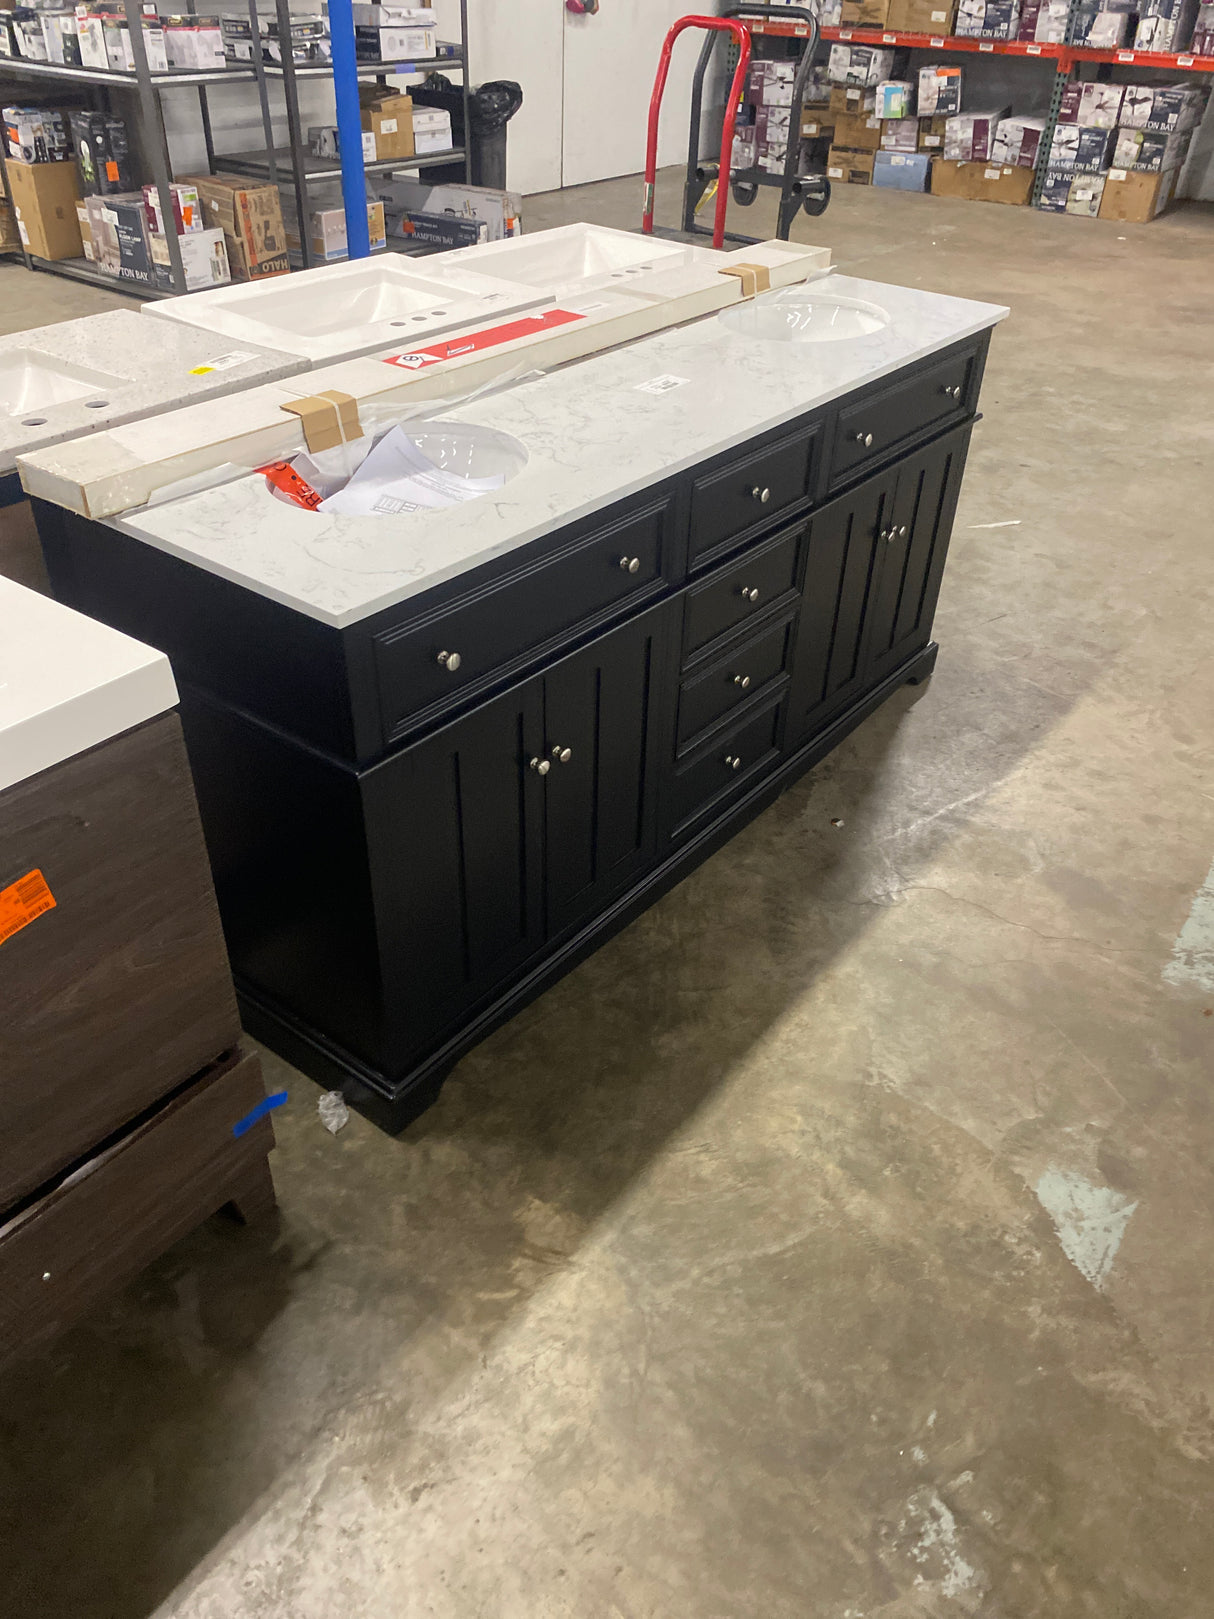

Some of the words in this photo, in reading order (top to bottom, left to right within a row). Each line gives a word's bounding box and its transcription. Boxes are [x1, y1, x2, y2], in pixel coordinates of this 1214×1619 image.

[1160, 122, 1175, 132] BAY
[1048, 159, 1085, 170] HAMPTON
[1085, 162, 1099, 171] BAY
[1147, 163, 1160, 171] BAY
[1048, 172, 1062, 180] BAY
[412, 231, 442, 242] HAMPTON
[442, 235, 454, 245] BAY
[262, 258, 288, 272] HALO
[135, 269, 149, 281] BAY
